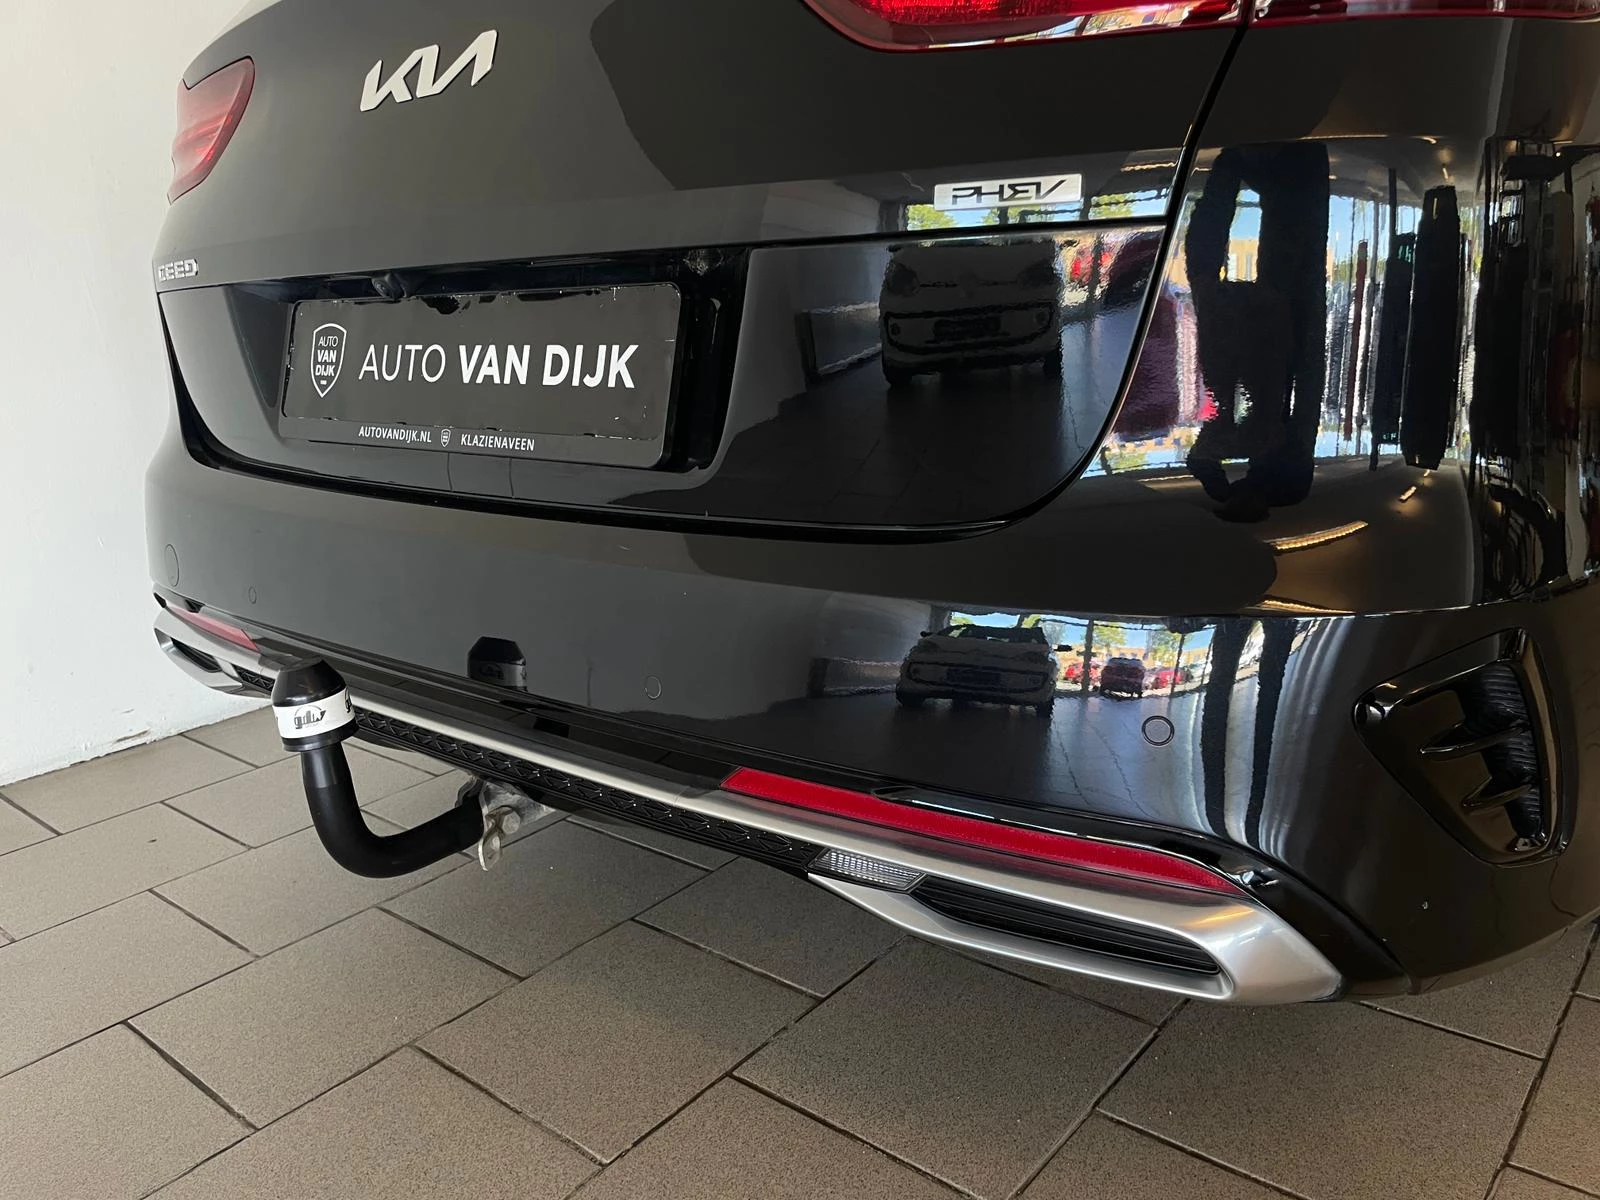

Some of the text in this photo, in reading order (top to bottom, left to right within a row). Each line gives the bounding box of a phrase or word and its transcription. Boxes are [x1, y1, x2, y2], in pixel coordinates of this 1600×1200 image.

[360, 29, 498, 112] KIA
[952, 179, 1068, 205] PHEV
[318, 336, 339, 347] AUTO
[317, 350, 337, 363] VAN
[358, 344, 639, 389] AUTO VAN DIJK
[315, 364, 336, 377] DIJK
[358, 426, 432, 444] AUTOVANDIJK.NL
[460, 433, 535, 452] KLAZIENAVEEN
